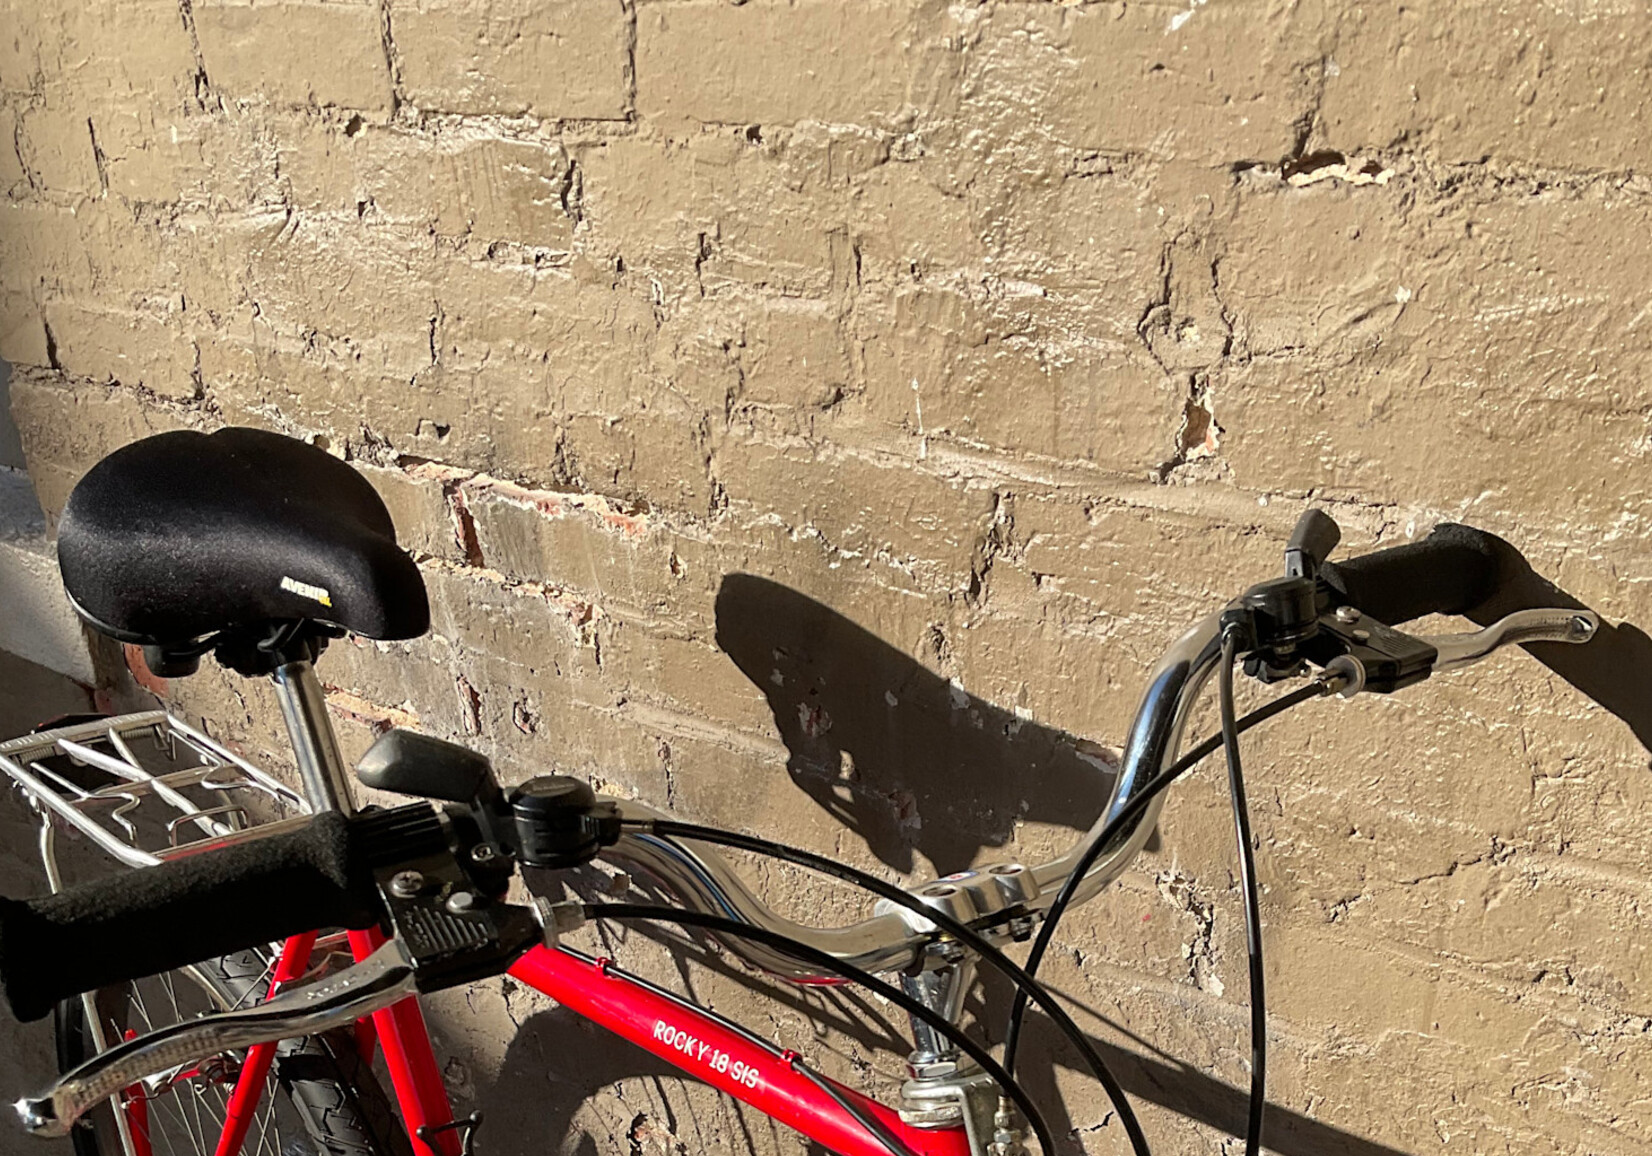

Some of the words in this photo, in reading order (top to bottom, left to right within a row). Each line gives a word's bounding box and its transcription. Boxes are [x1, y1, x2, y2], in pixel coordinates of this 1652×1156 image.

[653, 1020, 710, 1061] ROCKY
[709, 1049, 730, 1073] 18
[731, 1061, 760, 1088] SIS
